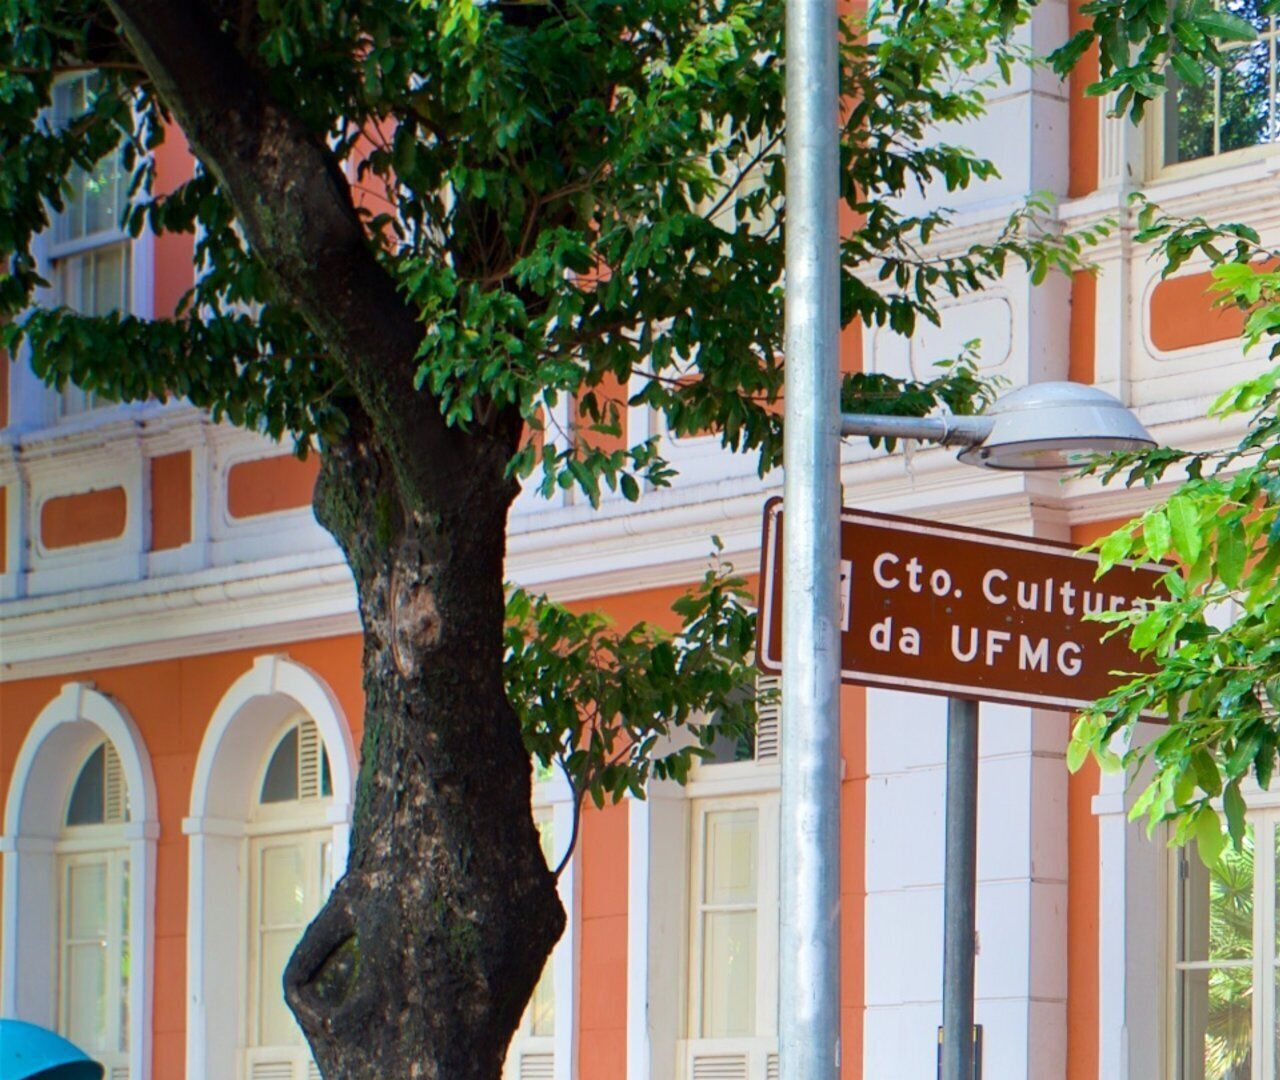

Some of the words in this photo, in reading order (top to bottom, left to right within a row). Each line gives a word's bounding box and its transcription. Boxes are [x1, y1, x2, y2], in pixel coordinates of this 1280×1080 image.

[873, 552, 963, 599] Cto.
[869, 617, 920, 656] da
[951, 625, 1084, 677] UFMG
